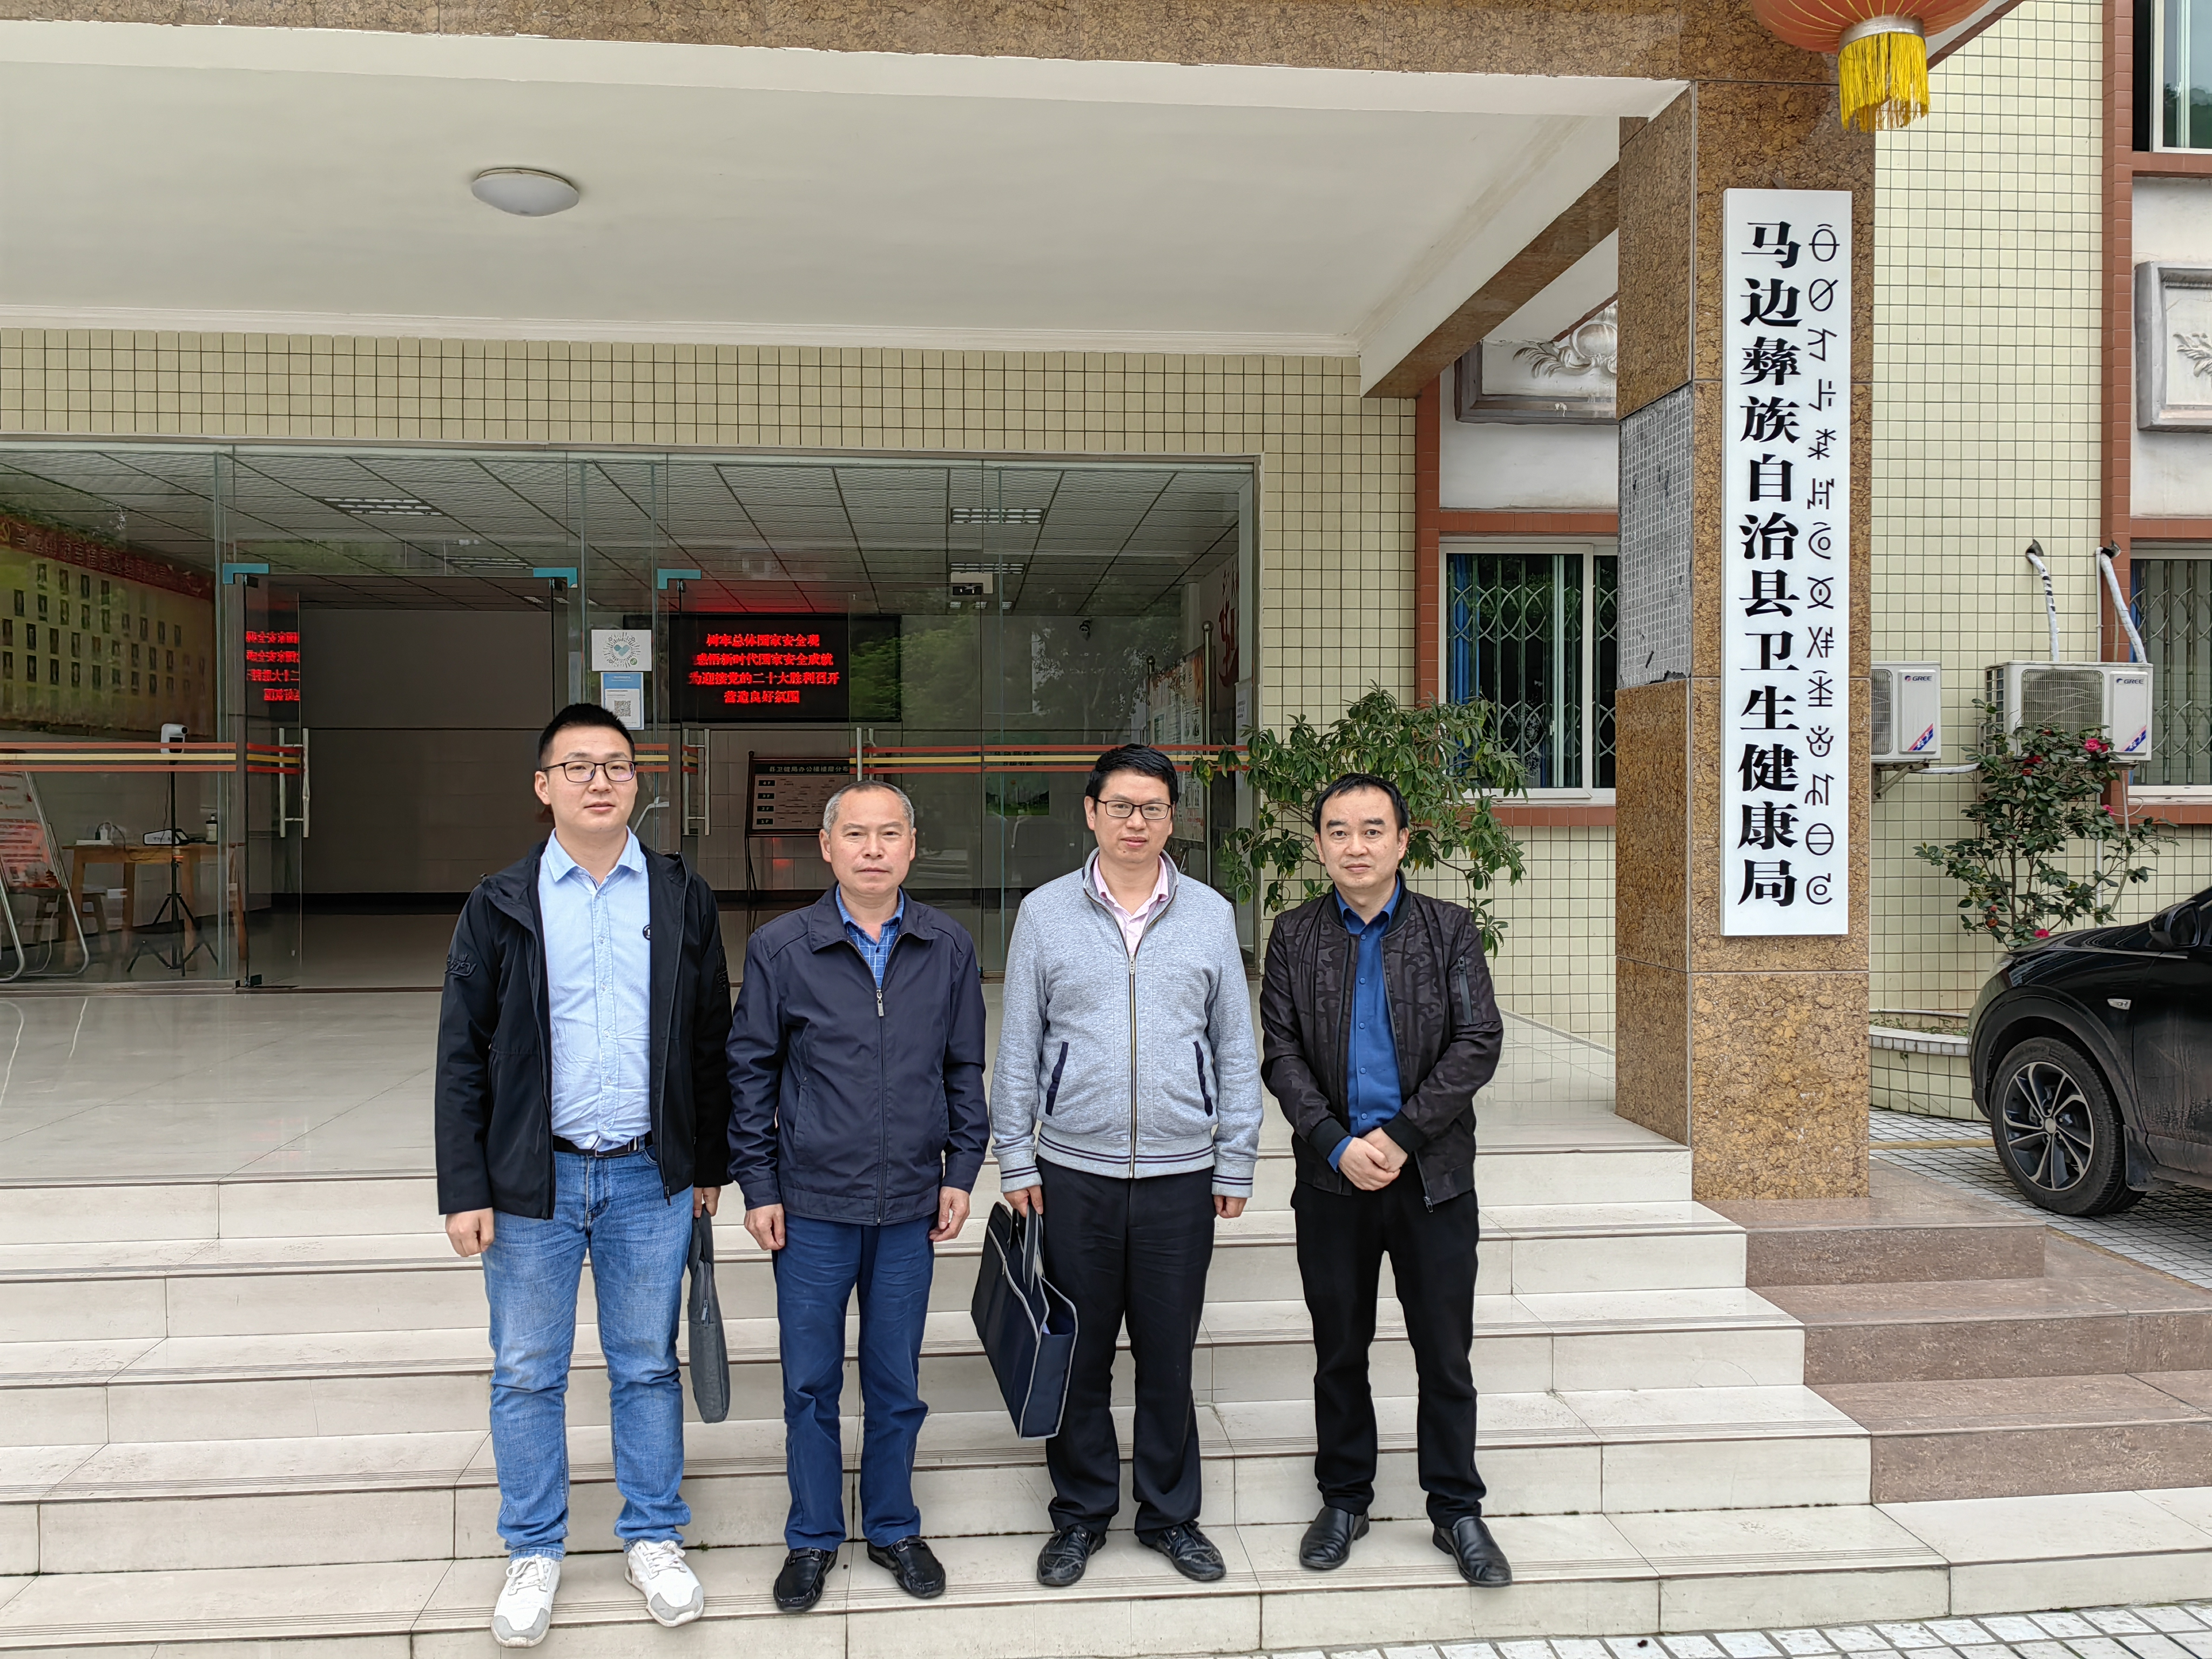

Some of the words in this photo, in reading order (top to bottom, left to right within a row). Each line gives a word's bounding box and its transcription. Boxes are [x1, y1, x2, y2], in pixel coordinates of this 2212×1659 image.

[1737, 221, 1802, 907] 马边彝族自治县卫生健康局
[706, 633, 820, 647] 树牢总体国家安全观
[693, 652, 834, 666] 感悟新时代国家安全成就
[688, 671, 840, 685] 为迎接党的二十大胜利召开
[724, 691, 799, 703] 营造良好氛围
